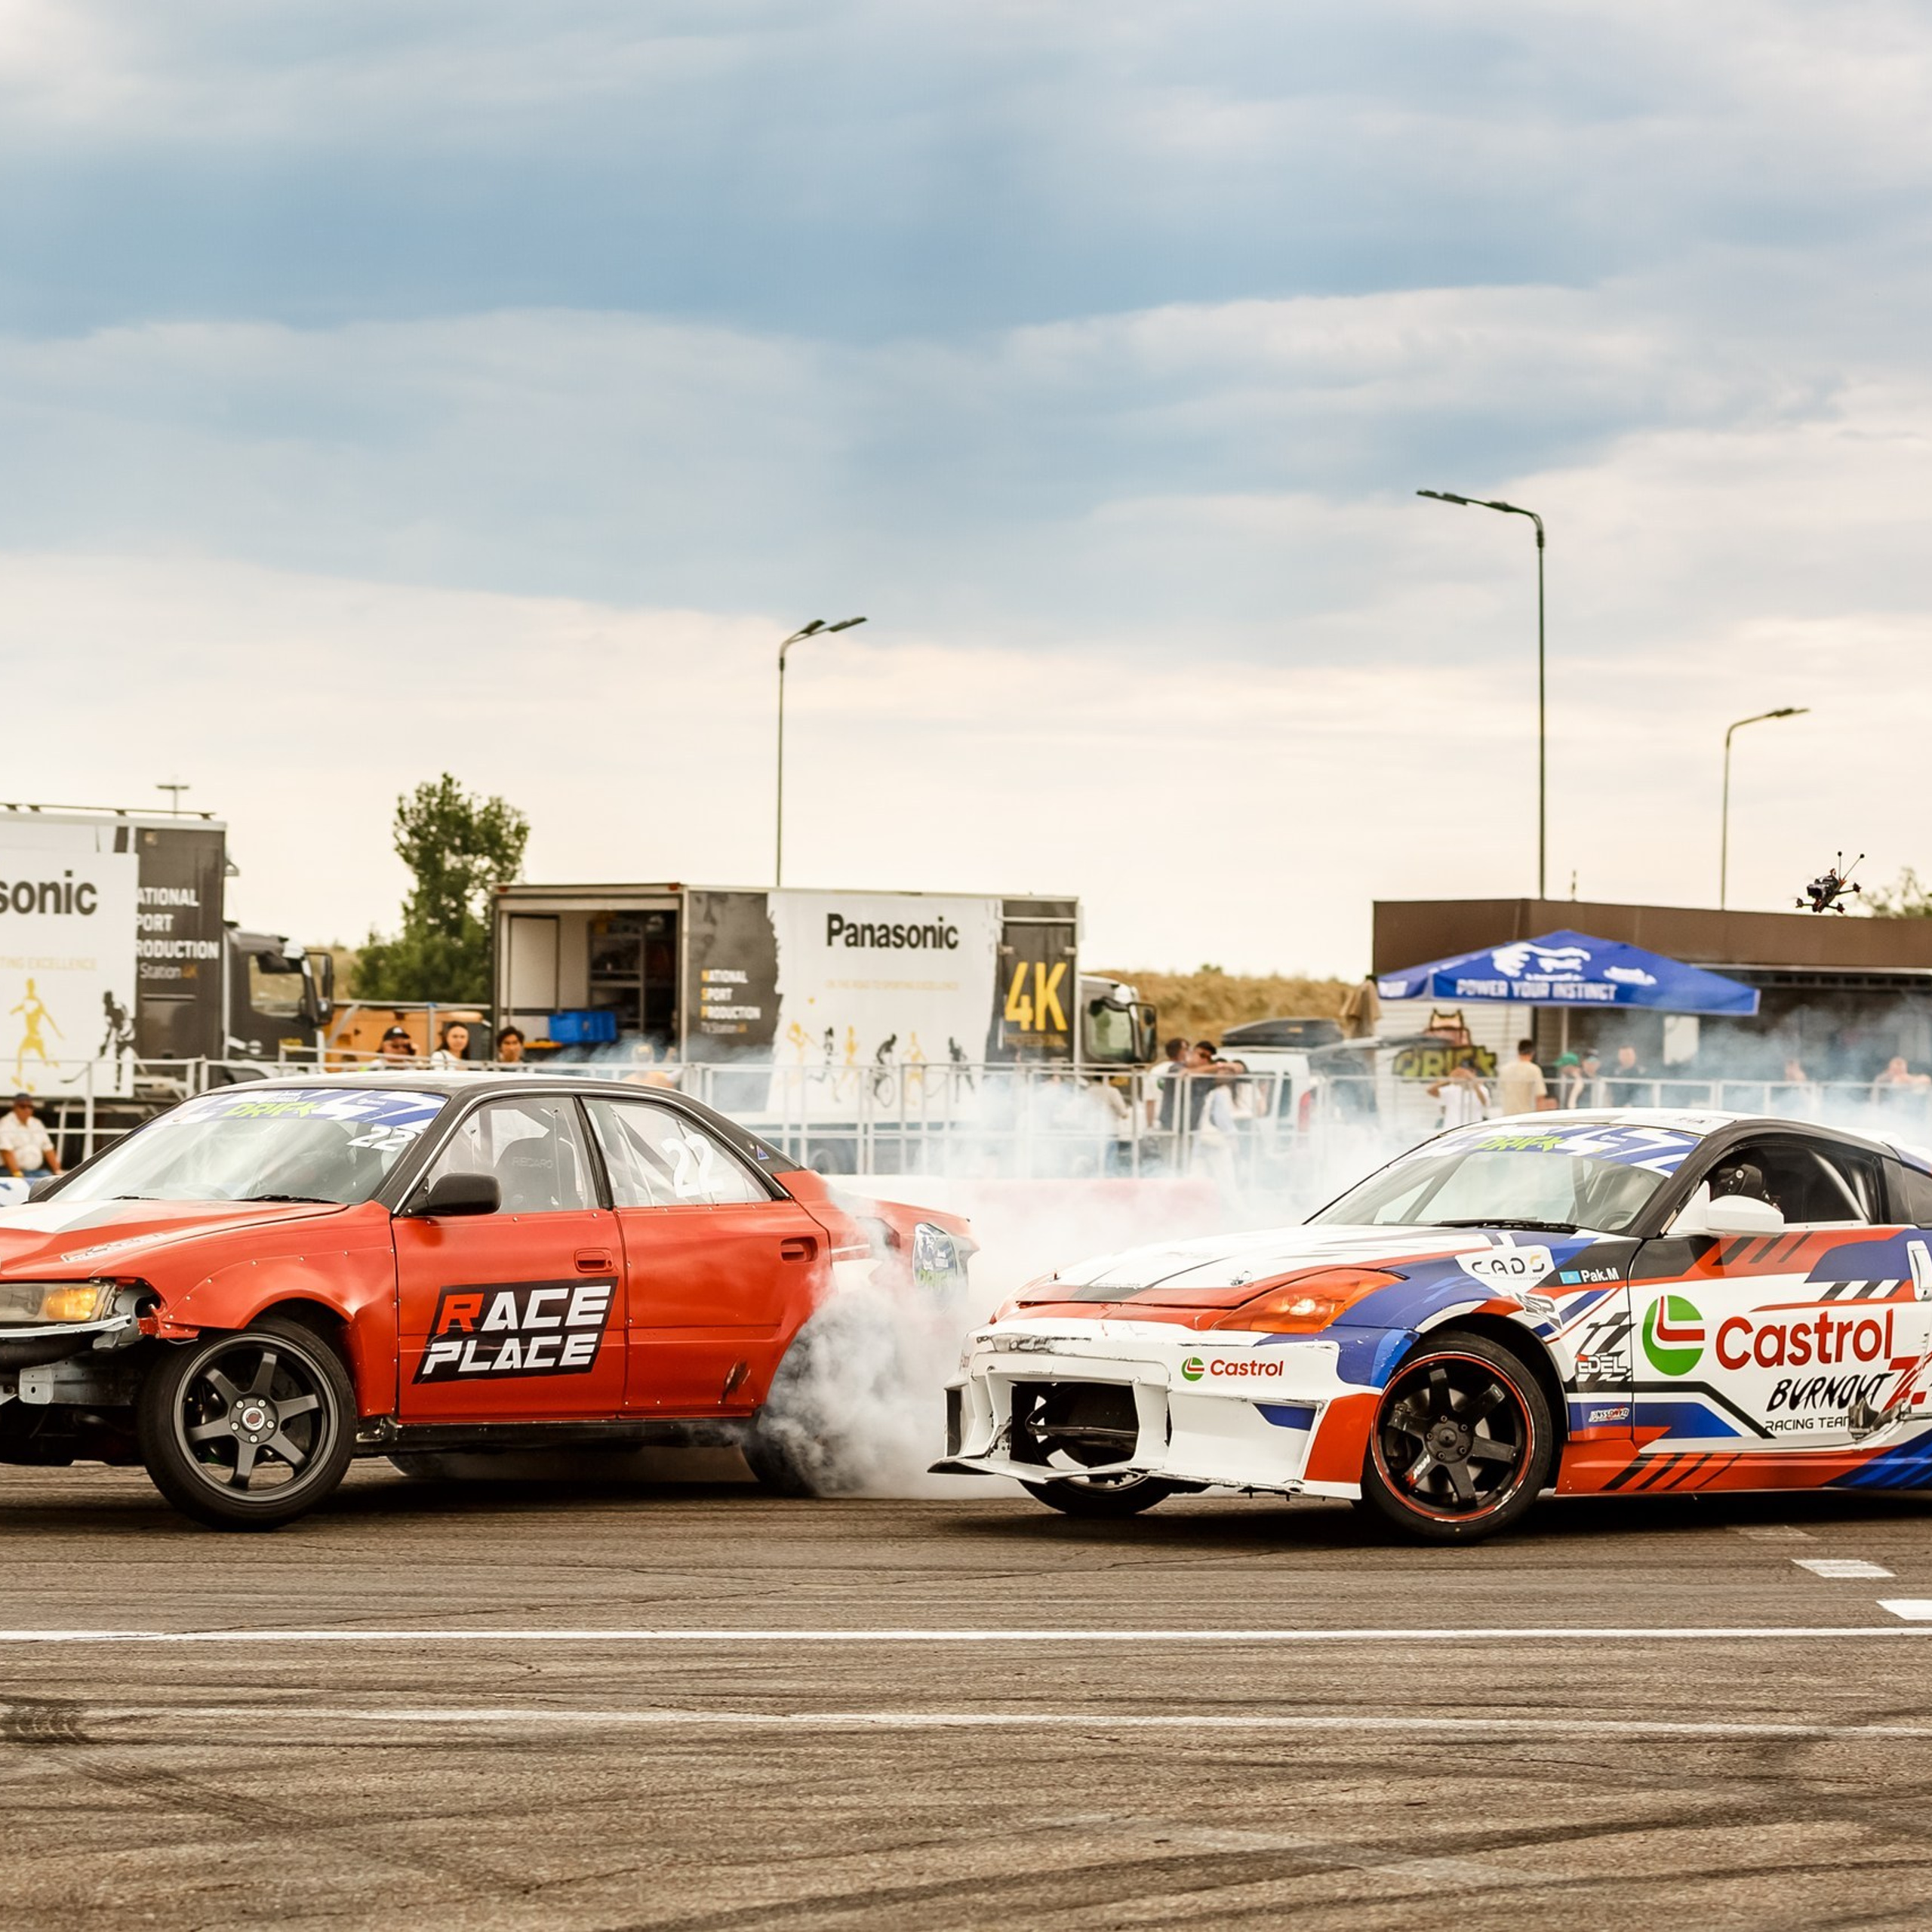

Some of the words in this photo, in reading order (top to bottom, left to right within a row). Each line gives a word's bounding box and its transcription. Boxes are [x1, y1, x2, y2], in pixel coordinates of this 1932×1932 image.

[826, 913, 958, 949] Panasonic
[1004, 961, 1068, 1032] 4K
[1456, 979, 1508, 997] POWER
[346, 1125, 417, 1152] 22
[660, 1134, 724, 1198] 22
[1580, 1267, 1620, 1282] Pak.M
[435, 1285, 611, 1334] RACE
[422, 1333, 598, 1375] PLACE
[1715, 1309, 1894, 1371] Castrol
[1210, 1359, 1284, 1377] Castrol
[1577, 1354, 1627, 1374] EDEL
[1766, 1372, 1895, 1412] BURNOUT
[1764, 1418, 1814, 1432] RACING
